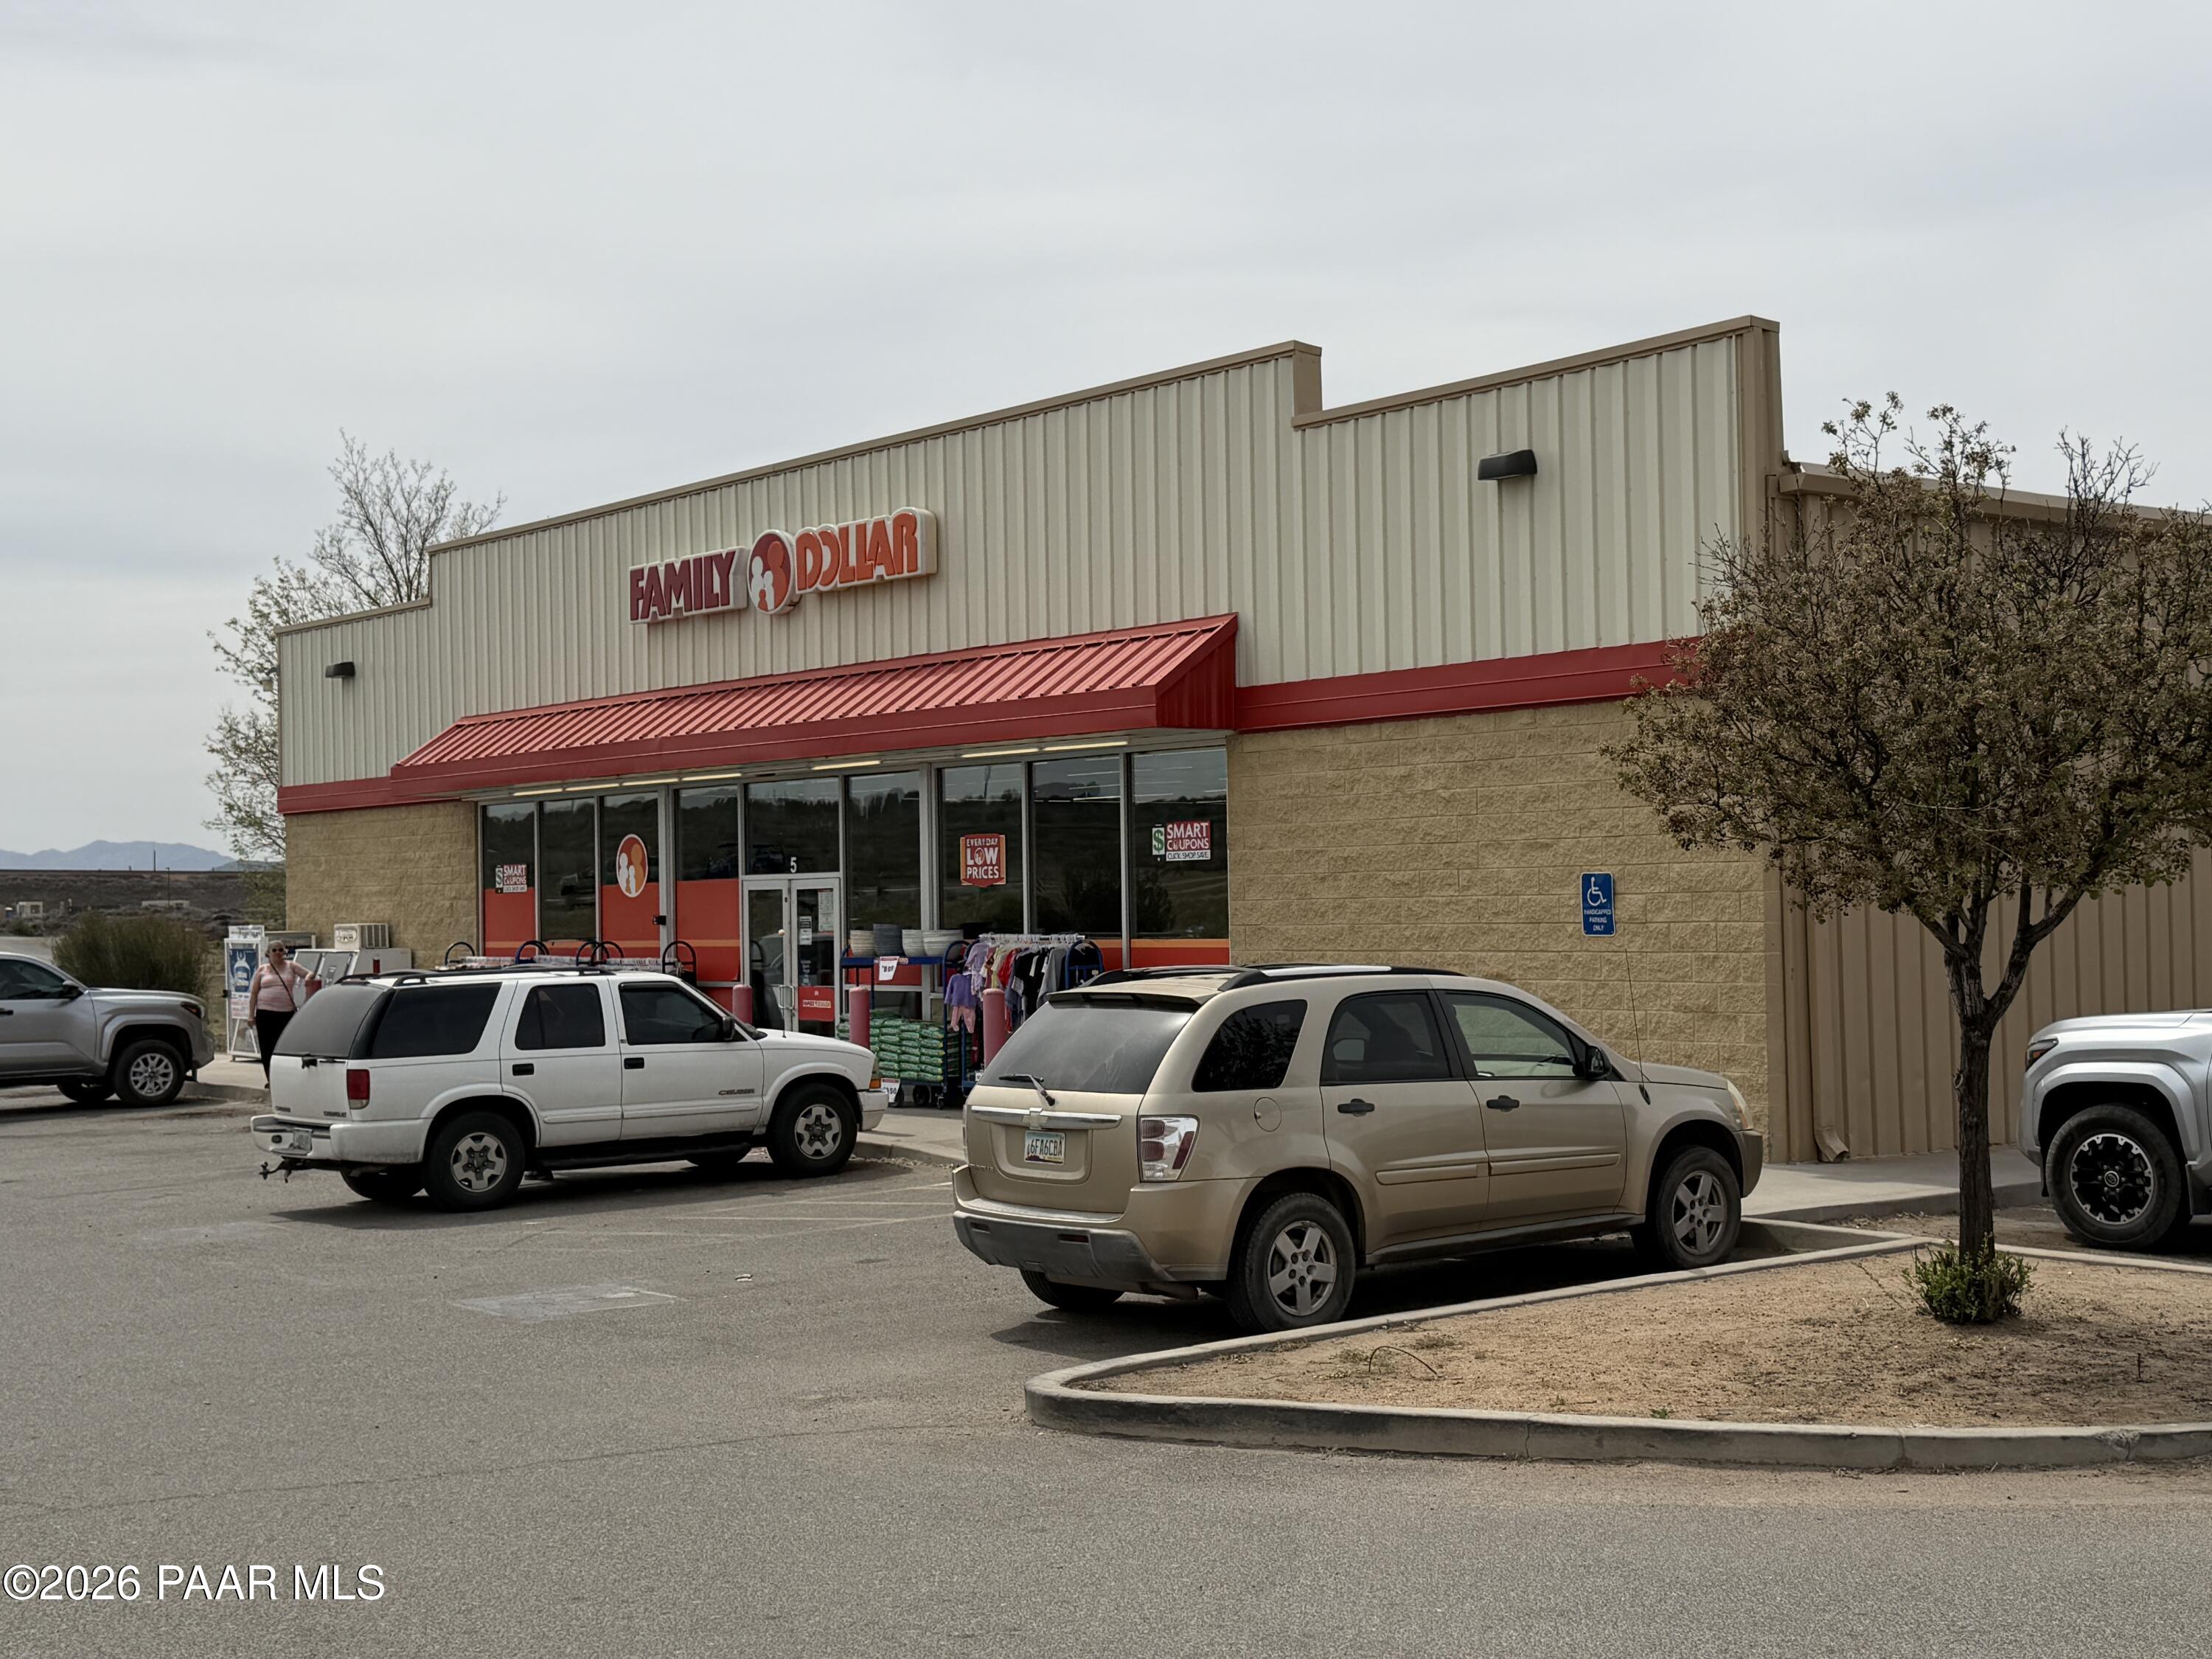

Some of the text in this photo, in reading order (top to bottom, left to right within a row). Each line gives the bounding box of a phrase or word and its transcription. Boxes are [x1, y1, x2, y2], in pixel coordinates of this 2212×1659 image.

[630, 512, 919, 621] FAMILY DOLLAR
[1166, 822, 1209, 839] SMART
[790, 856, 797, 874] 5
[967, 847, 999, 866] LOW
[504, 864, 526, 876] SMART
[967, 866, 999, 879] PRICES
